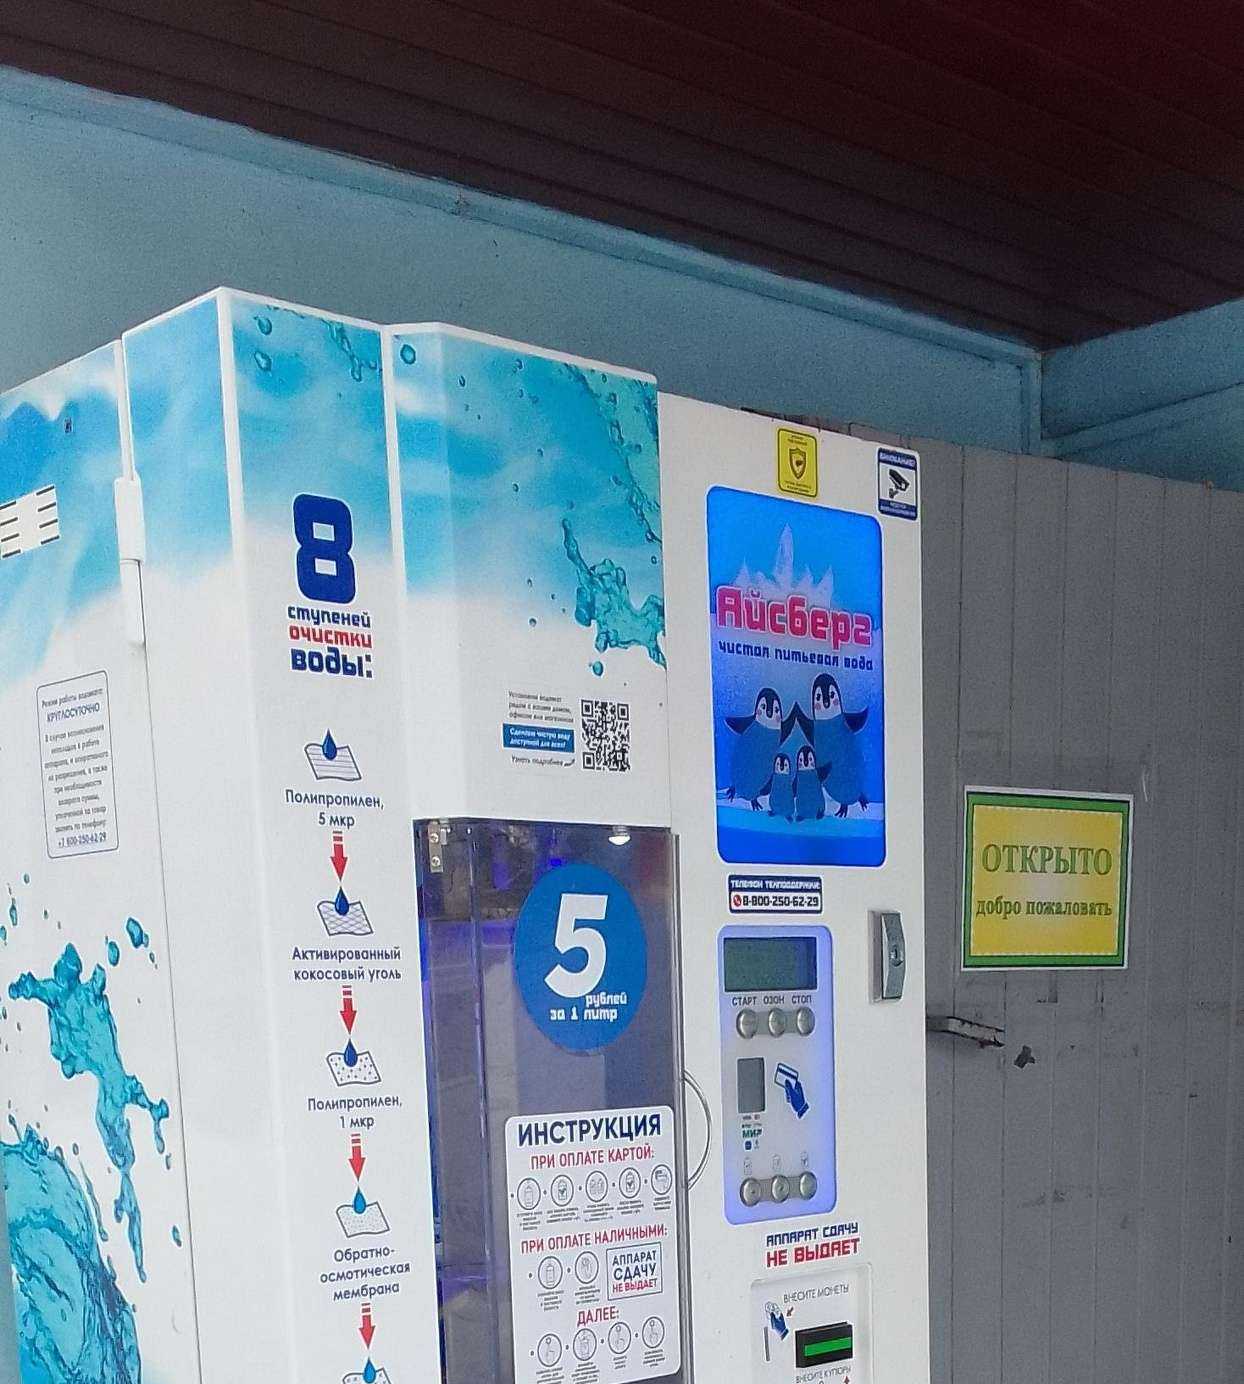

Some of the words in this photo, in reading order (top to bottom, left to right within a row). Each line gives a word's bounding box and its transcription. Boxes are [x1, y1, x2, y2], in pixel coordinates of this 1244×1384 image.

[293, 493, 356, 604] 8
[288, 606, 370, 628] ступеней
[716, 586, 872, 650] Айсберг
[289, 625, 372, 648] очистки
[291, 646, 372, 678] воды:
[718, 640, 770, 658] чистая
[775, 648, 838, 668] питьевая
[844, 656, 874, 670] вода
[47, 702, 100, 722] КРУГЛОСУТОЧНО
[286, 788, 384, 810] Полипропилен,
[318, 812, 326, 826] 5
[329, 814, 355, 830] мкр
[982, 843, 1113, 876] ОТКРЫТО
[742, 895, 819, 908] 8-800-250-62-29
[976, 896, 1021, 920] добро
[1026, 899, 1113, 917] пожаловать
[292, 947, 401, 964] Активированный
[544, 893, 608, 998] 5
[294, 966, 364, 981] кокосовый
[369, 968, 402, 982] уголь
[586, 992, 628, 1008] рублей
[732, 996, 758, 1006] СТАРТ
[763, 996, 784, 1005] ОЗОН
[791, 994, 812, 1004] СТОП
[550, 1008, 566, 1021] за
[570, 1007, 578, 1021] 1
[584, 1008, 618, 1022] литр
[308, 1096, 402, 1112] Полипропилен,
[340, 1116, 346, 1129] 1
[350, 1116, 374, 1130] мкр
[518, 1114, 661, 1147] ИНСТРУКЦИЯ
[742, 1128, 762, 1138] МИР
[531, 1154, 556, 1170] ПРИ
[560, 1150, 604, 1168] ОПЛАТЕ
[608, 1143, 655, 1163] КАРТОЙ:
[520, 1239, 544, 1256] ПРИ
[548, 1232, 592, 1251] ОПЛАТЕ
[594, 1223, 668, 1245] НАЛИЧНЫМИ:
[766, 1228, 819, 1247] АППАРАТ
[822, 1222, 858, 1238] СДАЧУ
[334, 1246, 395, 1265] Обратно-
[612, 1250, 657, 1267] АППАРАТ
[766, 1250, 788, 1268] НЕ
[794, 1238, 860, 1263] ВЫДАЕТ
[320, 1262, 411, 1284] осмотическая
[614, 1262, 656, 1282] СДАЧУ
[333, 1282, 400, 1302] мембрана
[612, 1282, 624, 1294] НЕ
[624, 1278, 658, 1292] ВЫДАЕТ
[784, 1288, 816, 1303] ВНЕСИТЕ
[817, 1284, 850, 1298] МОНЕТЫ
[576, 1305, 620, 1328] ДАЛЕЕ:
